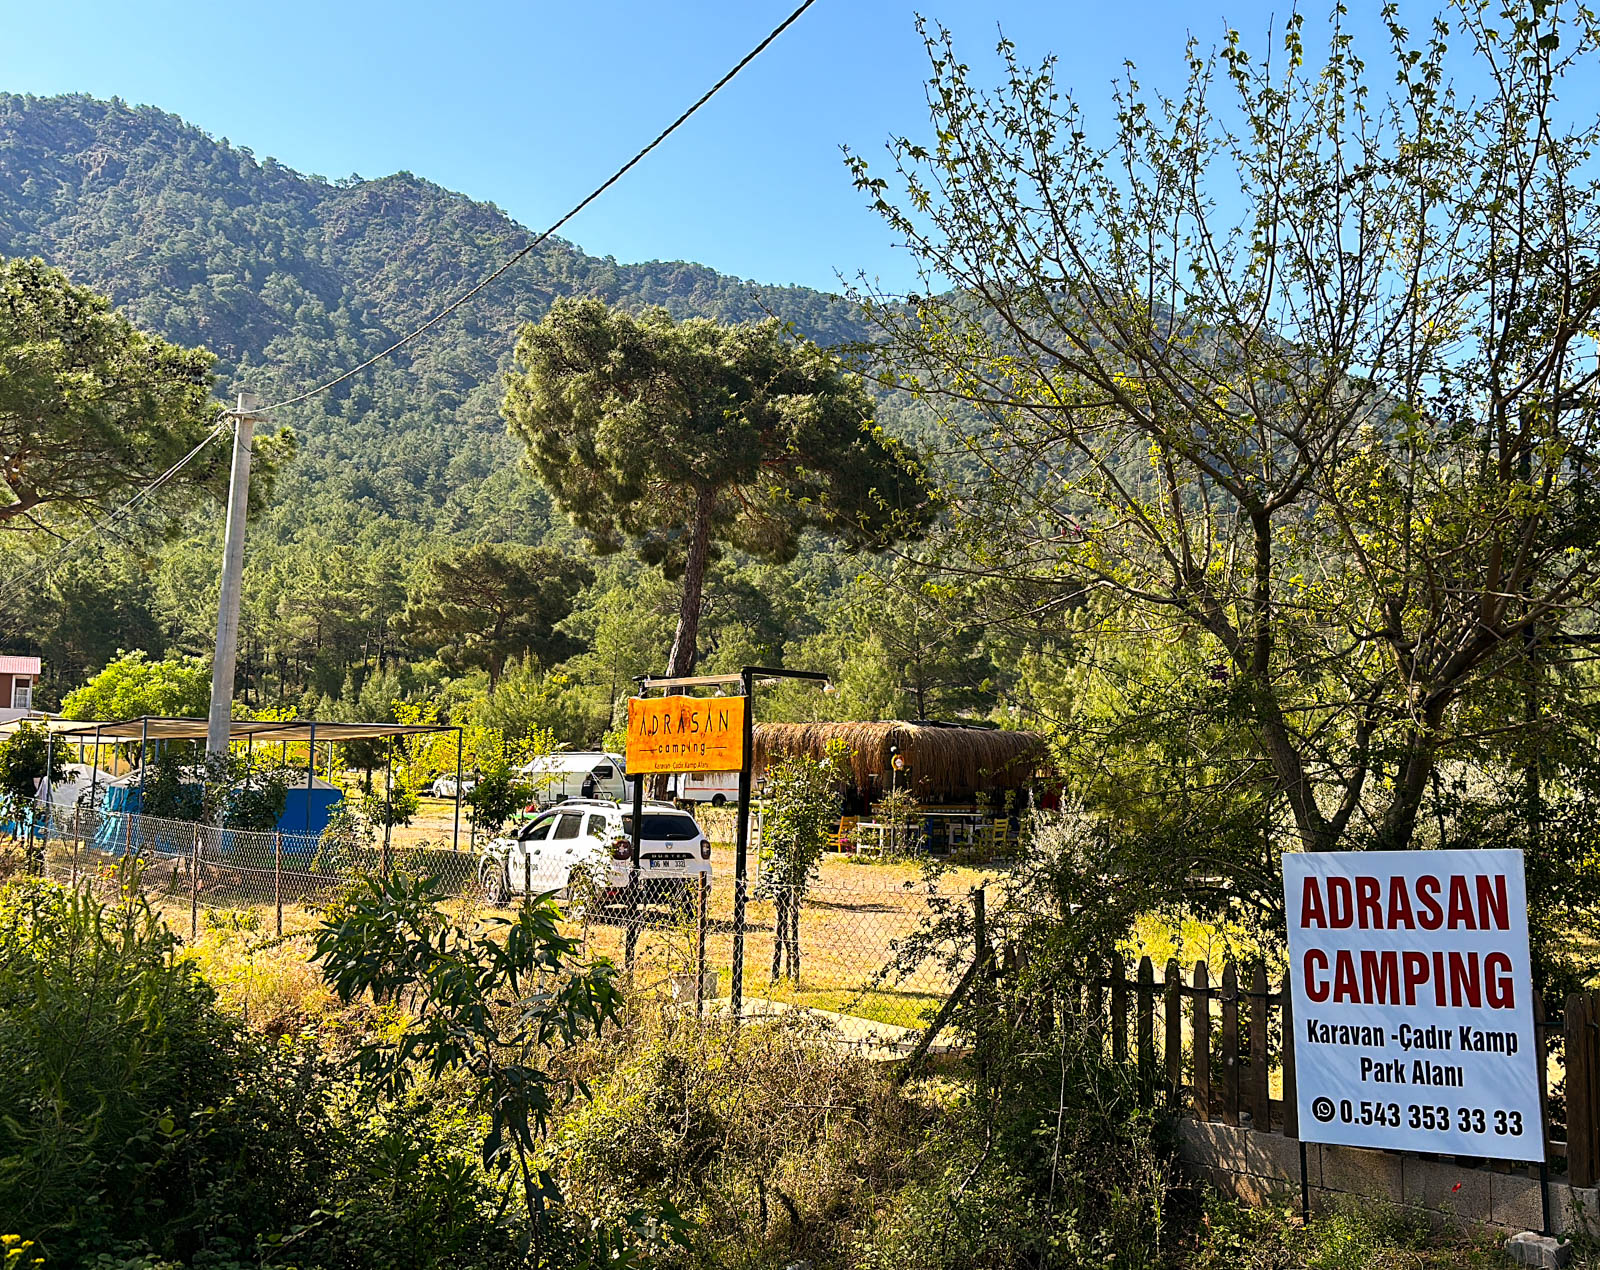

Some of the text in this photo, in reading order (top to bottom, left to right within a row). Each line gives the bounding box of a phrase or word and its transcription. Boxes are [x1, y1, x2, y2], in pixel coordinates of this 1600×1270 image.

[640, 702, 729, 737] ADRASAN
[658, 741, 706, 756] camping
[1300, 874, 1511, 931] ADRASAN
[1303, 948, 1516, 1010] CAMPING
[1306, 1019, 1385, 1047] Karavan
[1459, 1025, 1519, 1056] Kamp
[1360, 1057, 1464, 1087] Park Alanı
[1340, 1099, 1523, 1136] 0.543 353 33 33
